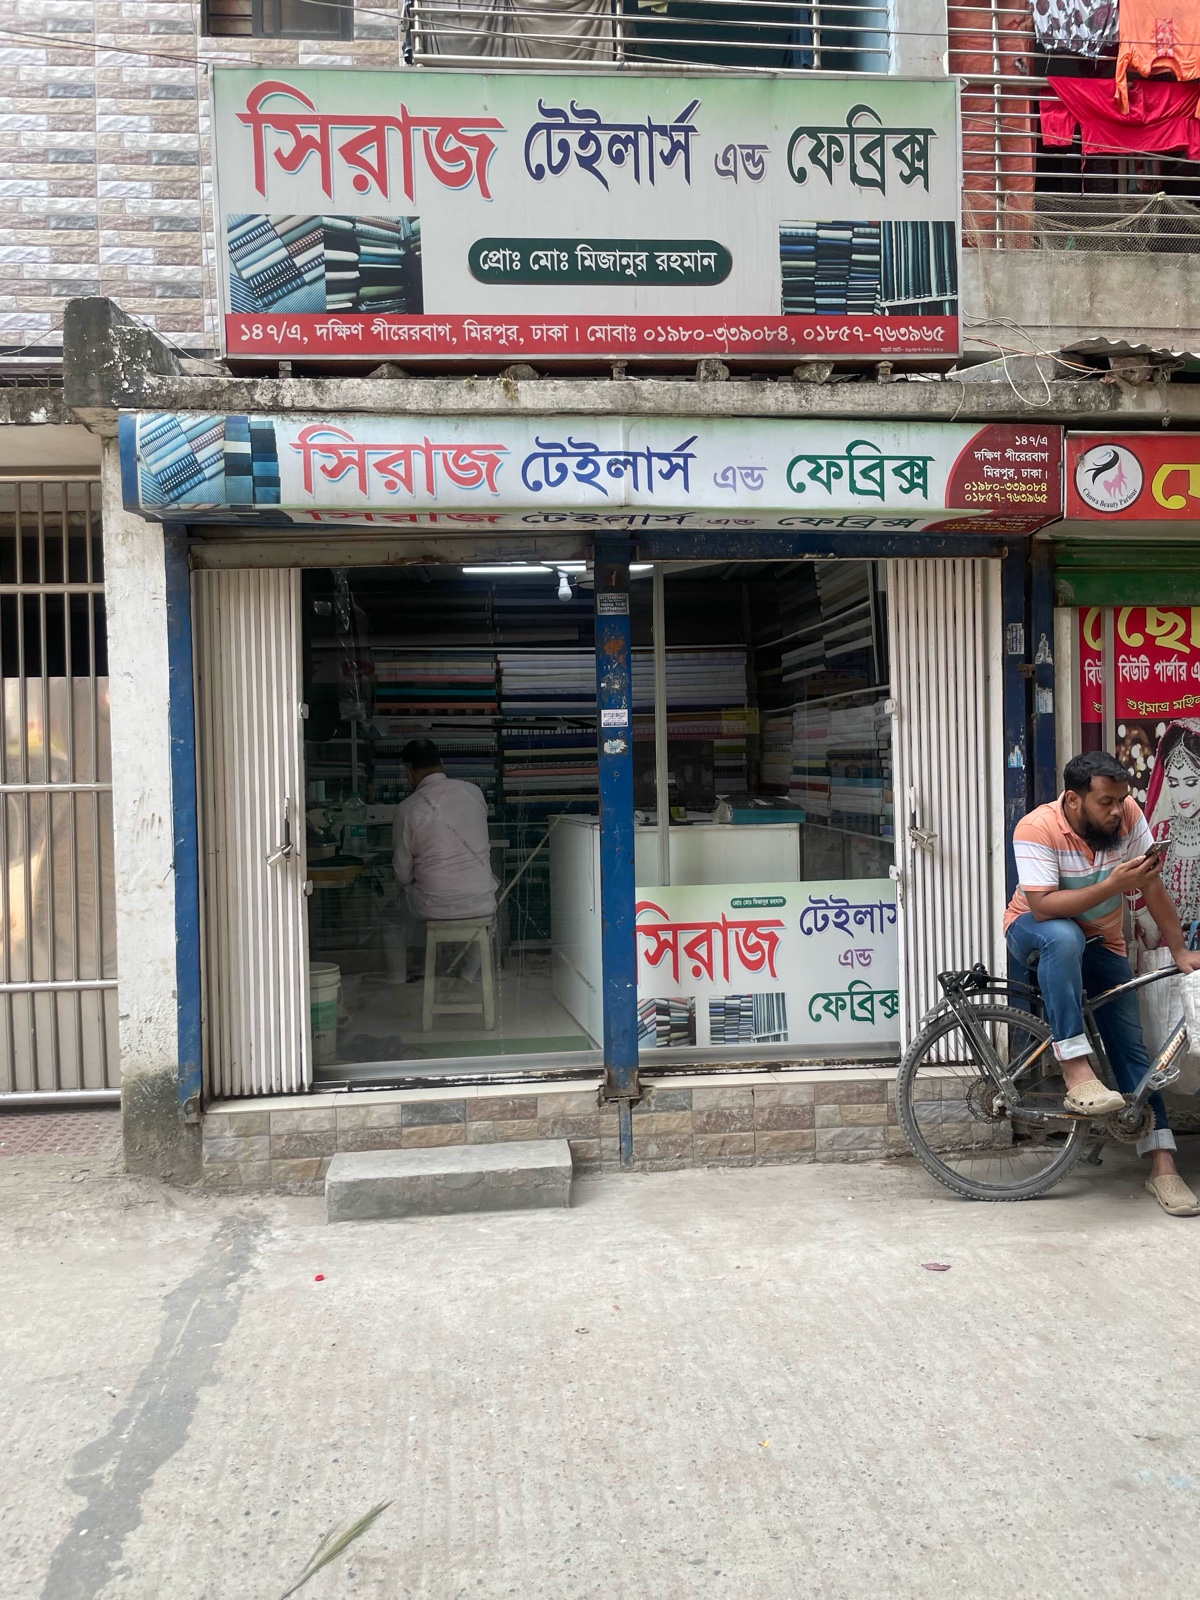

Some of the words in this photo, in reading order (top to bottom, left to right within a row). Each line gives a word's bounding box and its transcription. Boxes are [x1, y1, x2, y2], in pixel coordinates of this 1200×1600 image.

[235, 80, 504, 201] সিরাজ
[524, 98, 701, 193] টেইলার্স
[714, 144, 769, 184] এন্ড
[787, 104, 937, 197] ফেব্রিক্স
[479, 247, 521, 272] প্রোঃ
[530, 247, 569, 272] মোঃ
[575, 243, 650, 278] মিজানুর
[654, 249, 718, 275] রহমান
[240, 320, 309, 345] ১৪৭/এ,
[314, 319, 365, 342] দক্ষিণ
[370, 317, 458, 345] পীরেরবাগ,
[463, 318, 525, 346] মিরপুর,
[587, 324, 638, 343] মোবাঃ
[643, 325, 796, 345] ০১৯৮০-৩৩৯০৮৪,
[803, 325, 946, 343] ০১৮৫৭-৭৬৩৯৬৫
[1015, 435, 1048, 447] ১৪৭/এ
[290, 424, 509, 496] সিরাজ
[521, 435, 699, 497] টেইলার্স
[713, 465, 768, 494] এন্ড
[786, 439, 936, 502] ফেব্রিক্স
[973, 448, 1002, 462] দক্ষিণ
[1004, 448, 1049, 463] পীরেরবাগ
[983, 465, 1018, 480] মিরপুর,
[964, 482, 1048, 492] ০১৯৮০-৩৩৯০৮৪
[964, 492, 1048, 503] ০১৮৫৭-৭৬৩৯৬৫
[1099, 500, 1118, 509] Beauty
[1118, 488, 1138, 506] Parlour
[1118, 654, 1151, 683] বিউটি
[1154, 654, 1188, 683] পার্লার
[1126, 698, 1170, 715] শুধুমাত্র
[636, 901, 785, 984] সিরাজ
[838, 948, 874, 970] এন্ড
